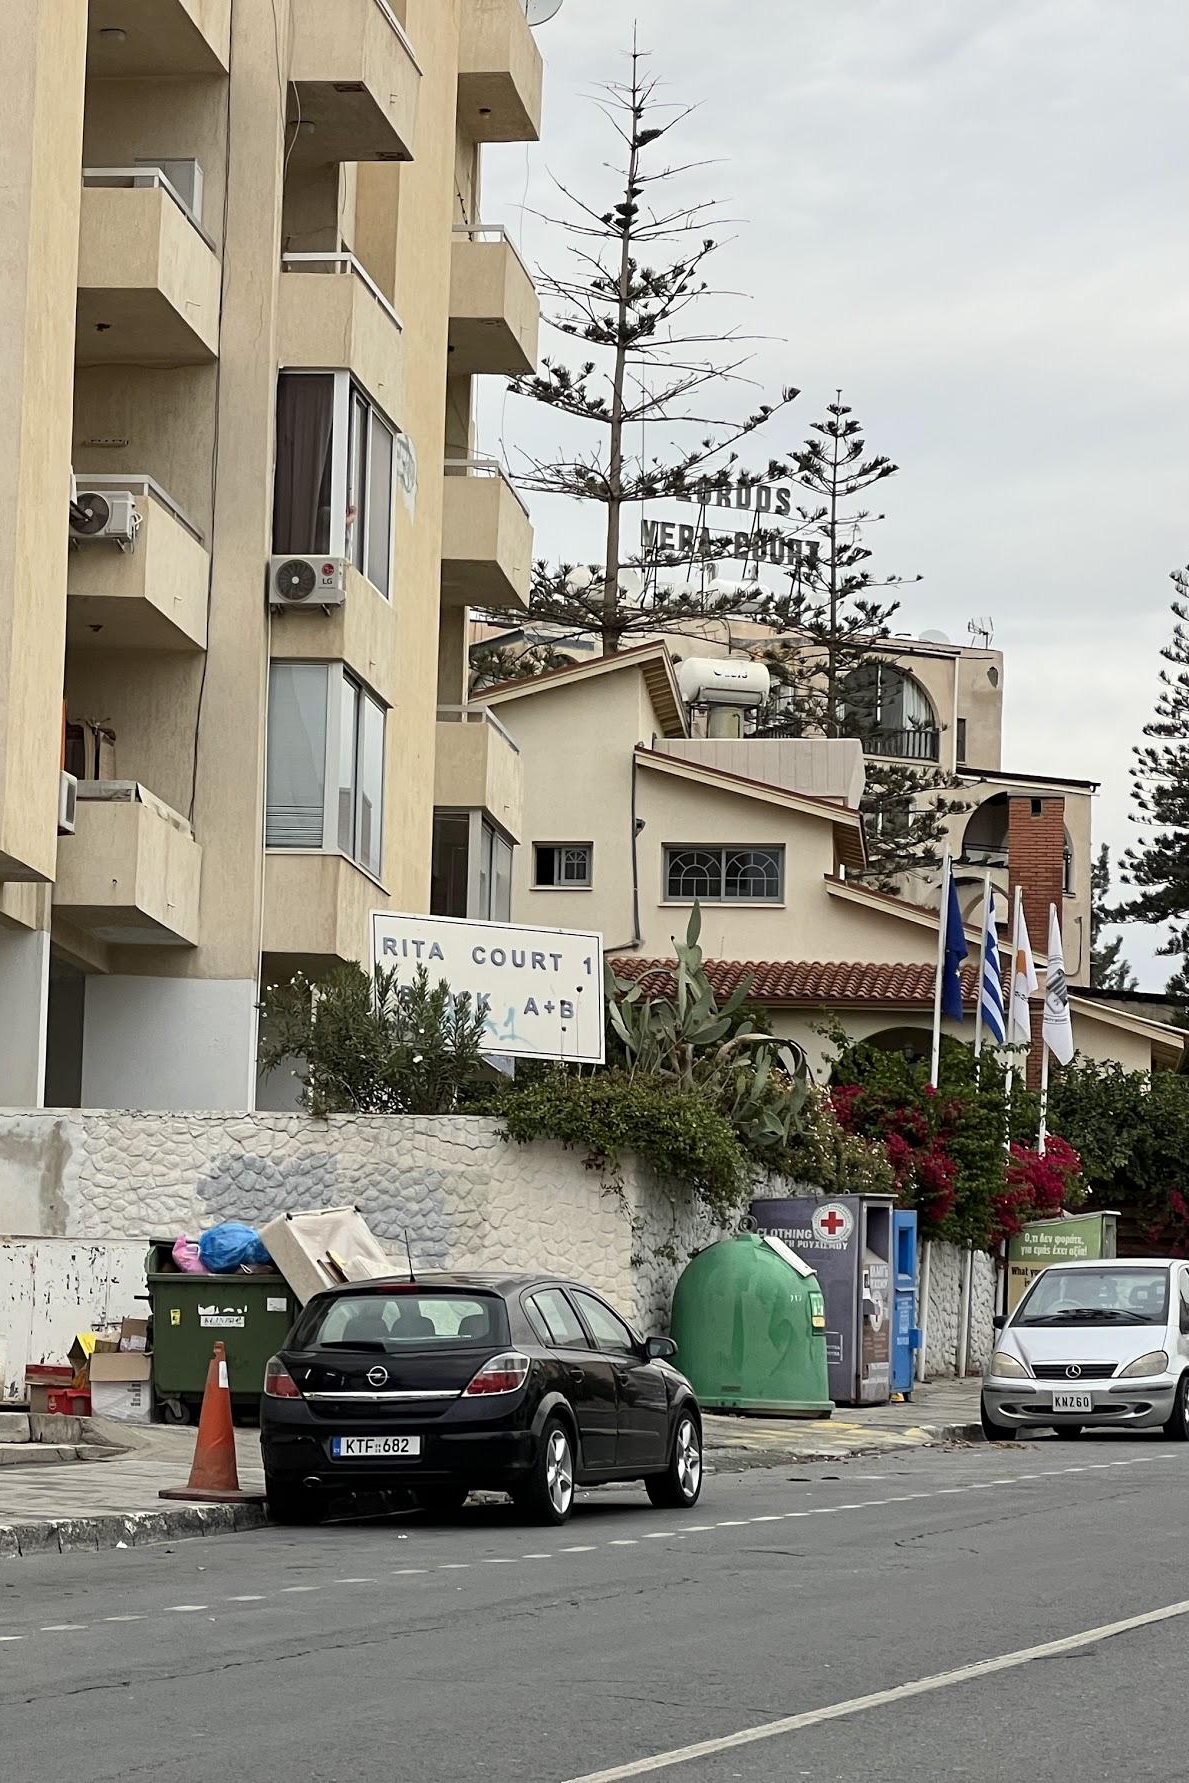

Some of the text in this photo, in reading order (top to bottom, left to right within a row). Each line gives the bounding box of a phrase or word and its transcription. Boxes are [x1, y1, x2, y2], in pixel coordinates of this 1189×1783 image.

[382, 936, 592, 975] RITA COURT 1
[523, 997, 574, 1019] A+B
[757, 1228, 812, 1239] CLOTHING
[346, 1439, 375, 1454] KTF
[383, 1438, 409, 1453] 682
